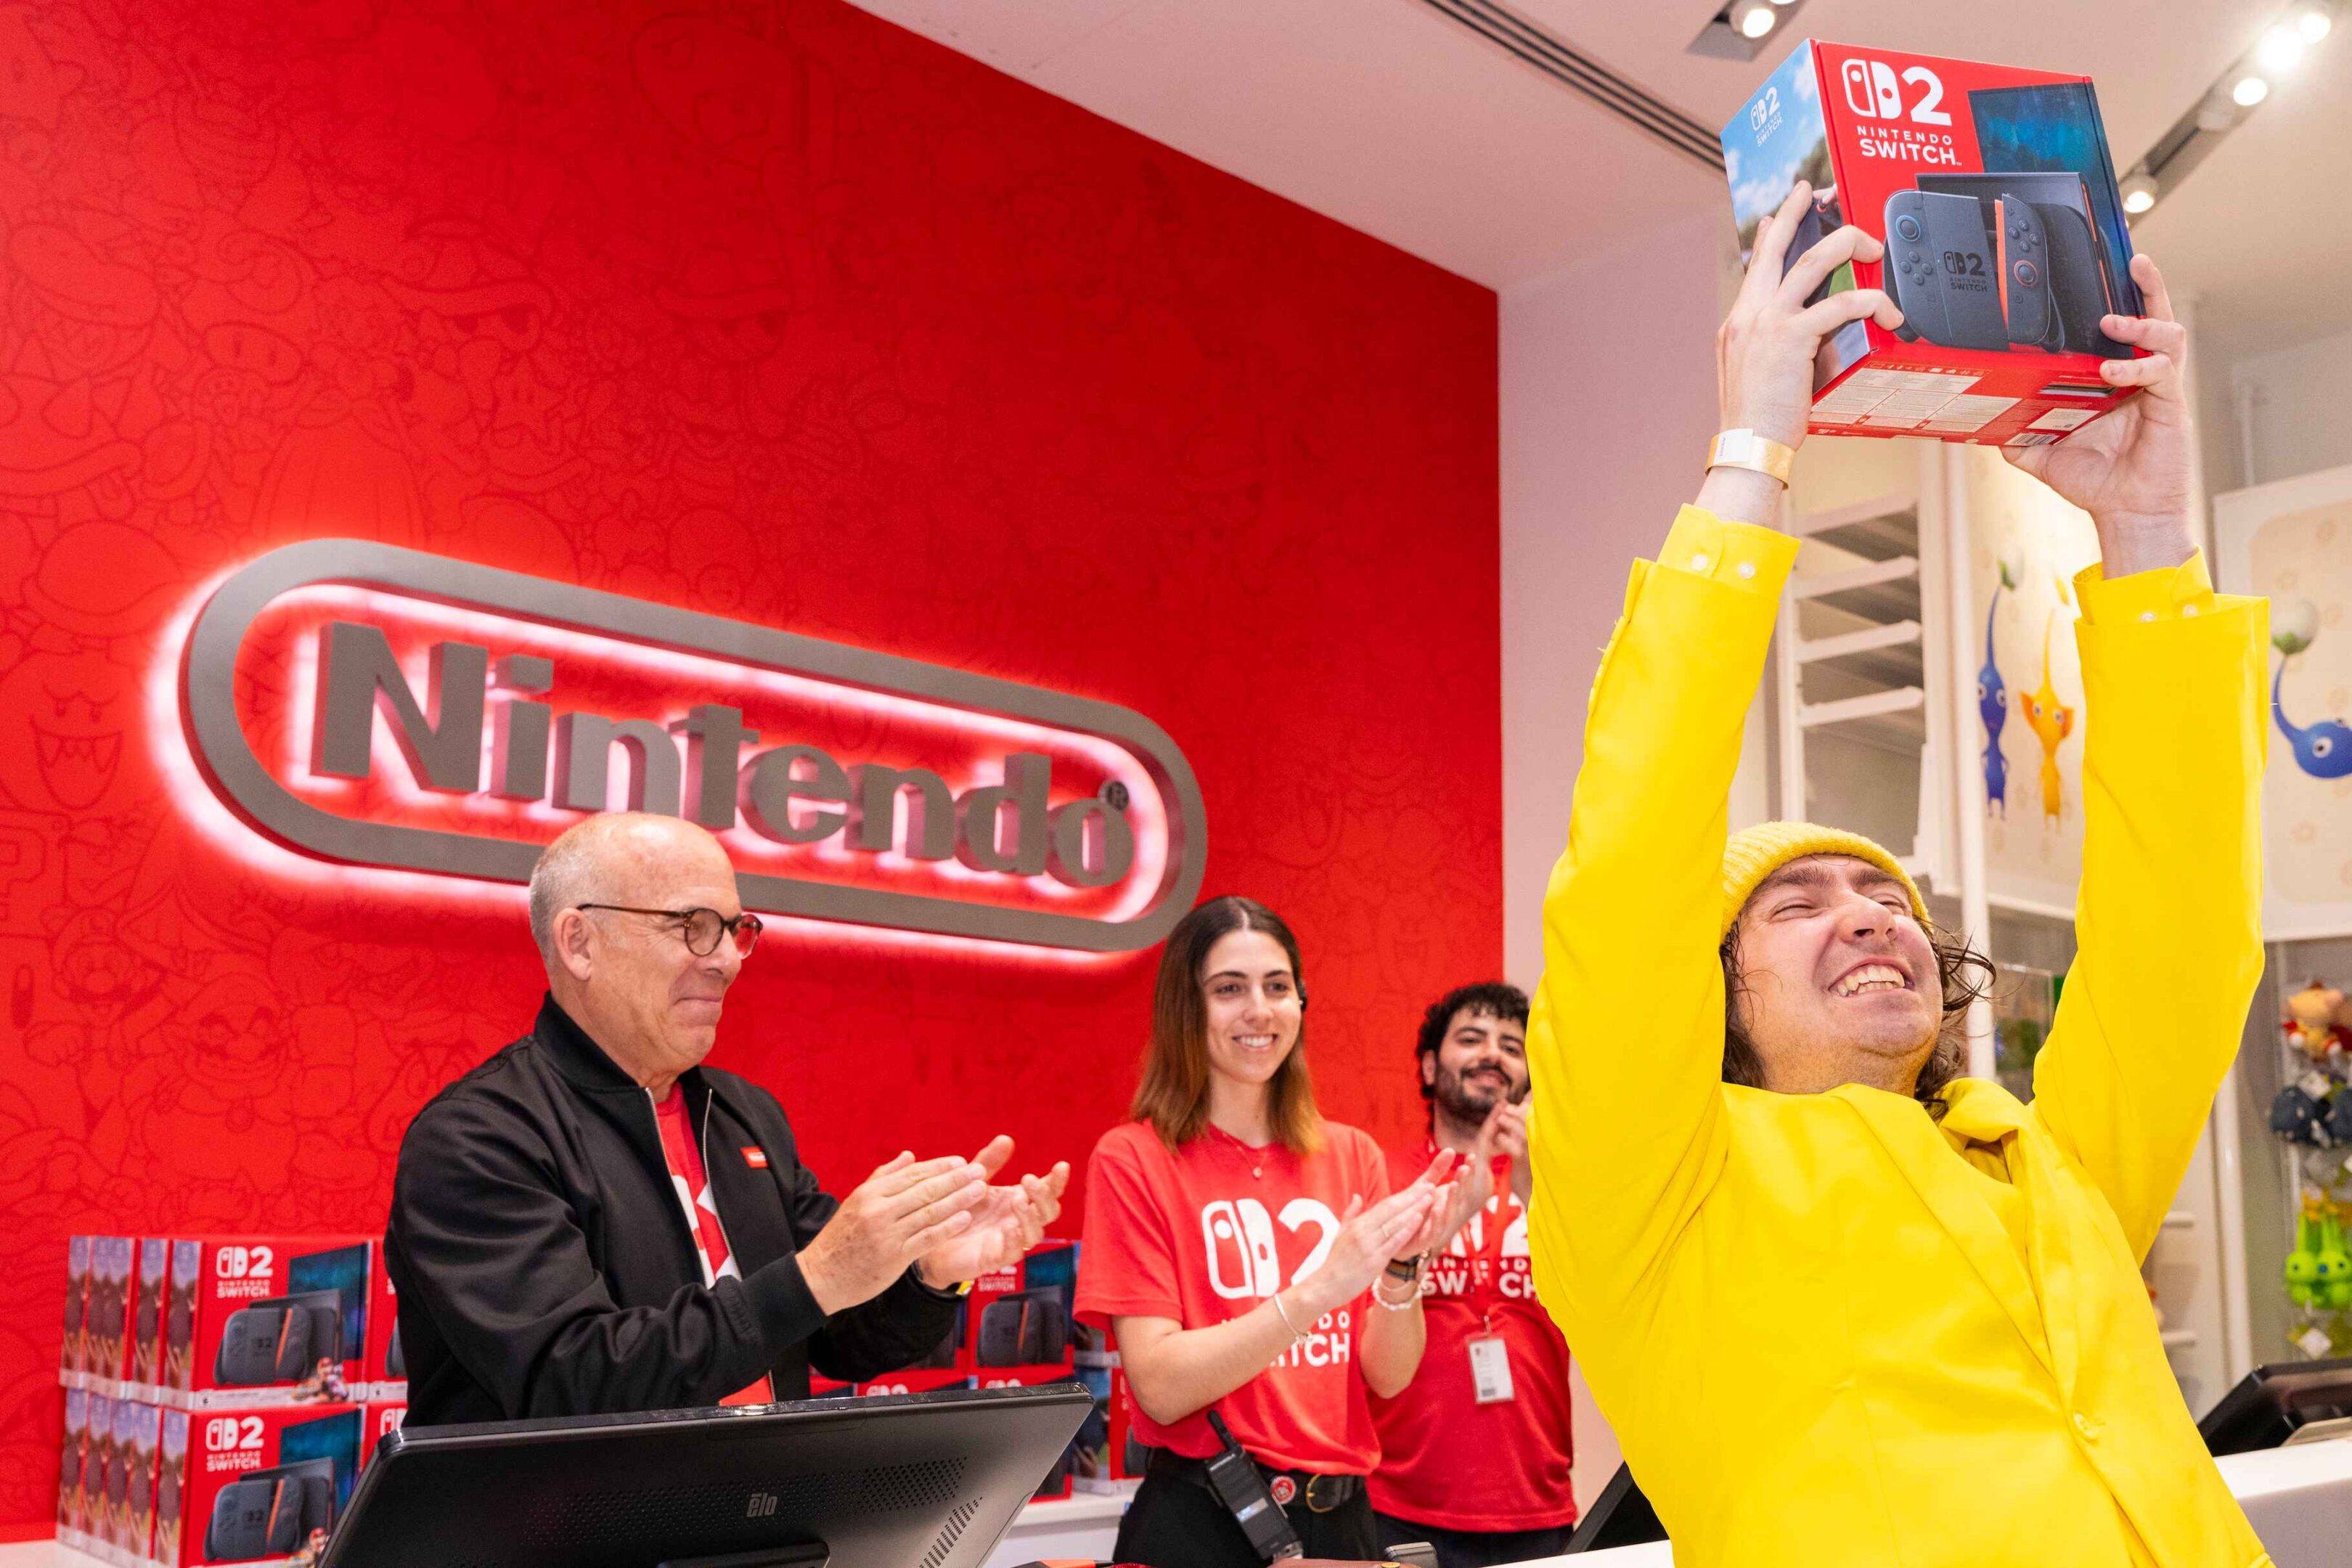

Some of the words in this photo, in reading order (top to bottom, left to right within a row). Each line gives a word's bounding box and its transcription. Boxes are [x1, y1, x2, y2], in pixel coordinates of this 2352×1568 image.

[1901, 66, 1952, 126] 2
[1857, 125, 1952, 145] NINTENDO
[1859, 138, 1956, 166] SWITCH
[1967, 253, 1986, 277] 2
[1951, 282, 1988, 292] SWITCH
[310, 621, 1135, 889] Nintendo
[249, 1246, 273, 1278] 2
[217, 1286, 270, 1299] SWITCH
[239, 1416, 264, 1450] 2
[206, 1458, 261, 1472] SWITCH
